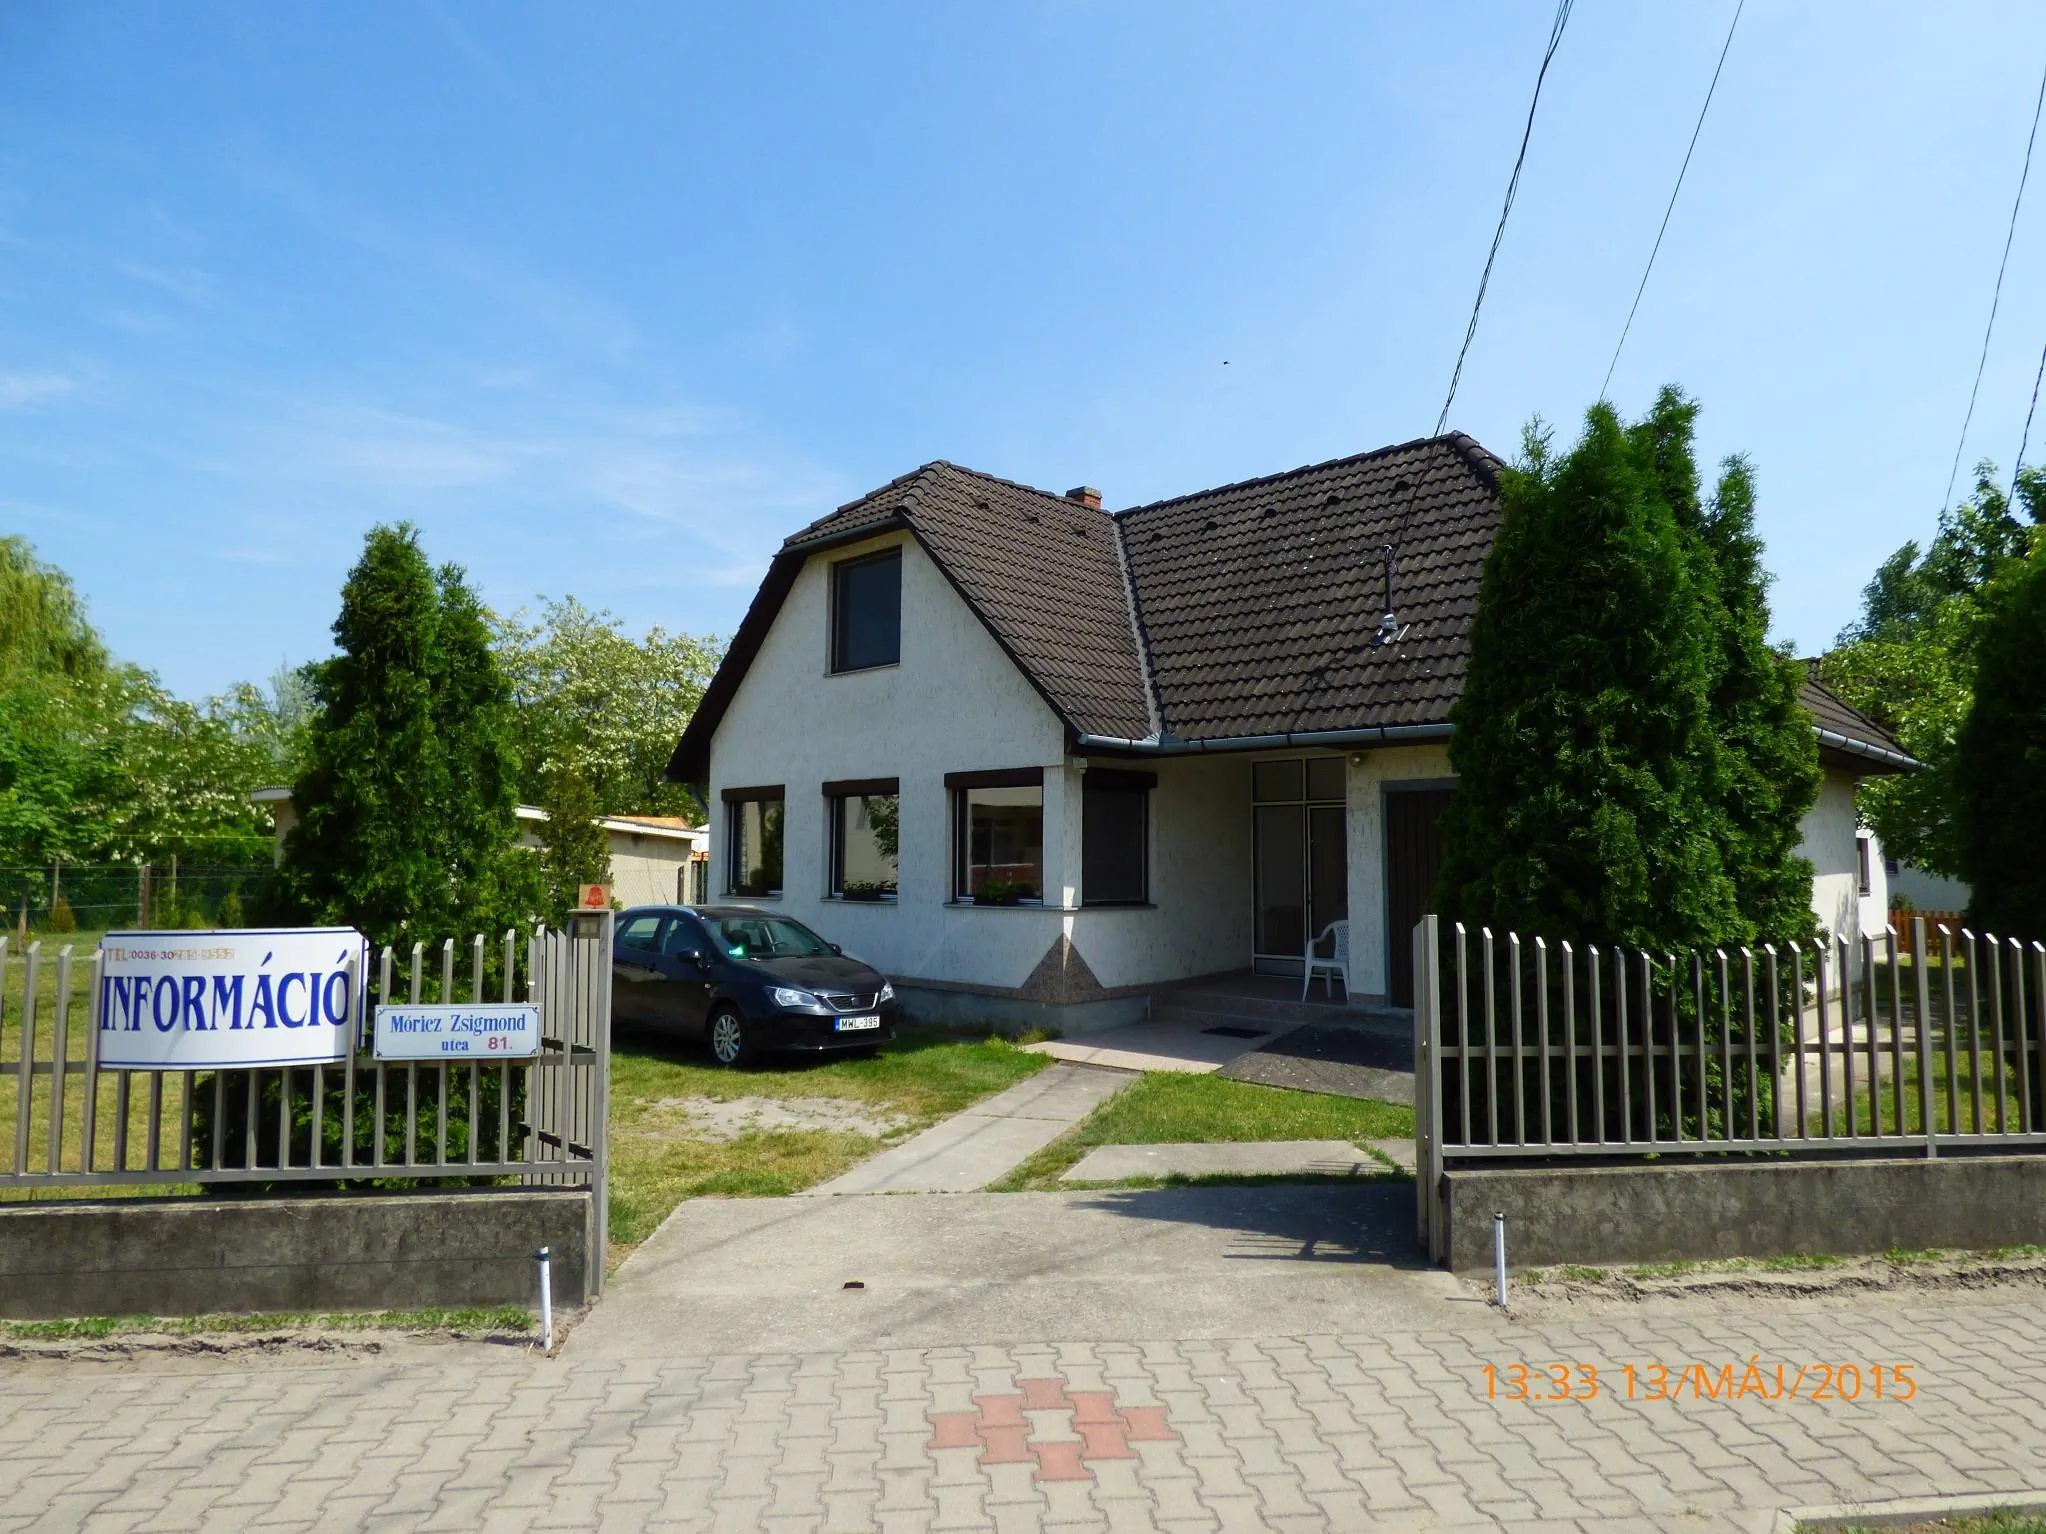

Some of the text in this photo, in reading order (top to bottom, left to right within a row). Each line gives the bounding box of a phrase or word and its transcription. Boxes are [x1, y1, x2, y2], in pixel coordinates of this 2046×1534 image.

[101, 949, 350, 1033] INFORMÁCIÓ
[390, 1013, 527, 1036] Móricz Zsigmond
[841, 1017, 878, 1029] MWL-395
[441, 1038, 469, 1052] utca
